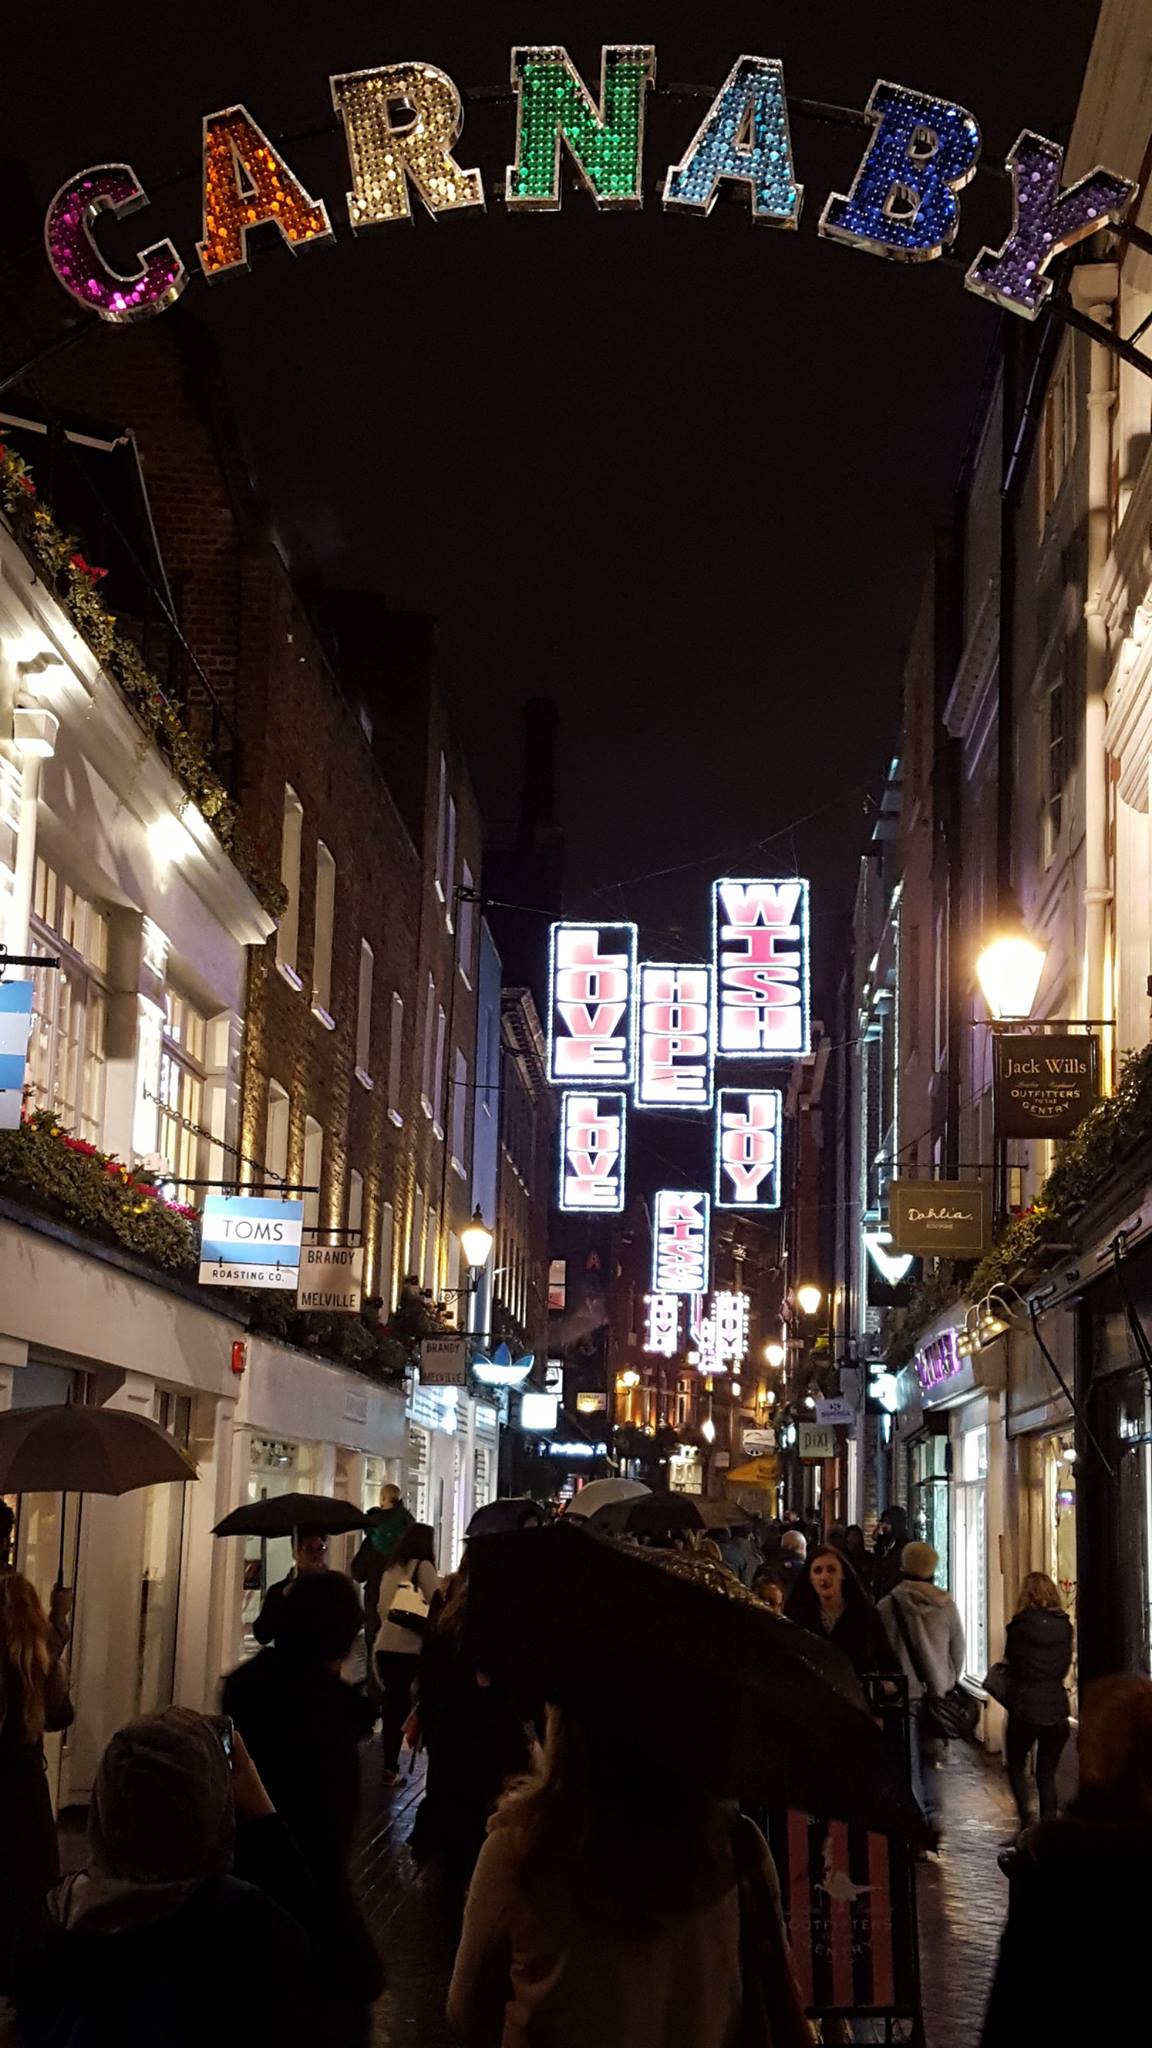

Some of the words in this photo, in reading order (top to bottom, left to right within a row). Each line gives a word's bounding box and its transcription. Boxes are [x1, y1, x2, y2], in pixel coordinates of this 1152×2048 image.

[43, 43, 1139, 321] CARNABY
[719, 884, 802, 1050] WISH
[555, 930, 628, 1075] LOVE
[641, 969, 708, 1103] HOPE
[1004, 1058, 1040, 1078] Jack
[1045, 1058, 1087, 1074] Wills
[1010, 1089, 1080, 1098] OUTFITTERS
[1022, 1101, 1071, 1115] GENTRY
[564, 1098, 619, 1205] LOVE
[722, 1095, 775, 1201] JOY
[907, 1207, 971, 1221] Dahlia
[222, 1219, 284, 1242] TOMS
[658, 1193, 704, 1290] KISS
[307, 1250, 356, 1265] BRANDY
[212, 1269, 264, 1281] ROASTING
[268, 1272, 285, 1283] CO.
[301, 1292, 356, 1308] MELVILLE
[426, 1342, 461, 1354] BRANDY
